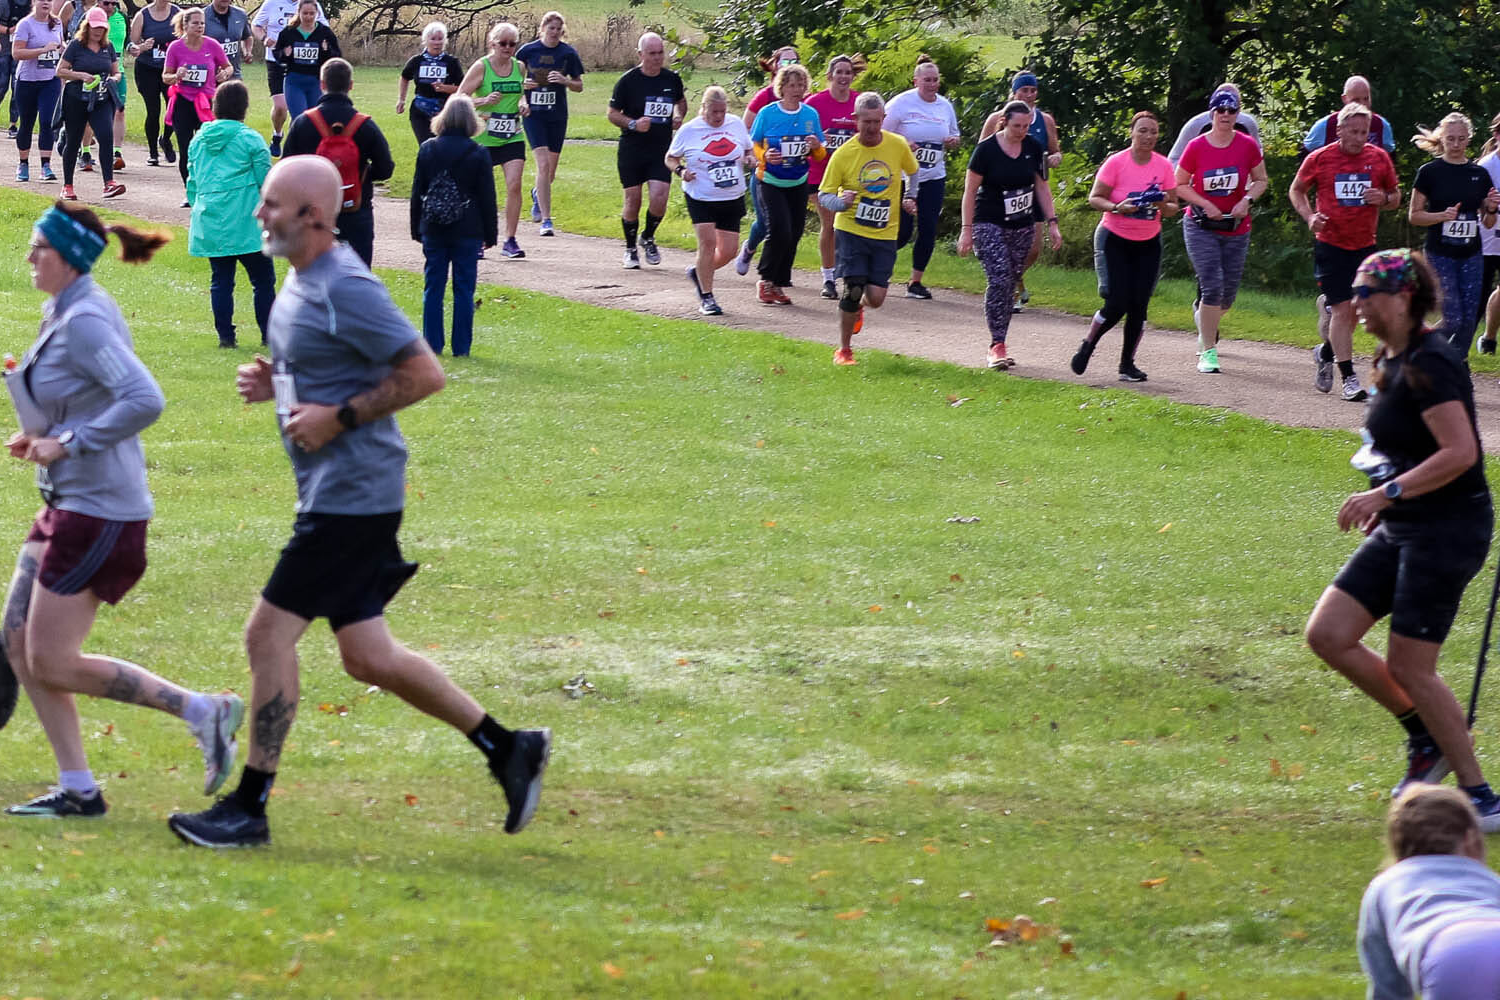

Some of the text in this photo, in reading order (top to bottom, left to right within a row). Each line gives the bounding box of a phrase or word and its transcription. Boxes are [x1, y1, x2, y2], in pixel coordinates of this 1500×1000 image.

[297, 47, 318, 59] 1302
[426, 66, 441, 77] 150
[650, 102, 667, 115] 886
[494, 119, 511, 131] 252
[916, 148, 935, 163] 810
[714, 166, 734, 180] 842
[1210, 175, 1231, 190] 647
[1342, 183, 1364, 197] 442
[1011, 195, 1028, 212] 960
[861, 205, 889, 221] 1402
[1449, 222, 1471, 235] 441
